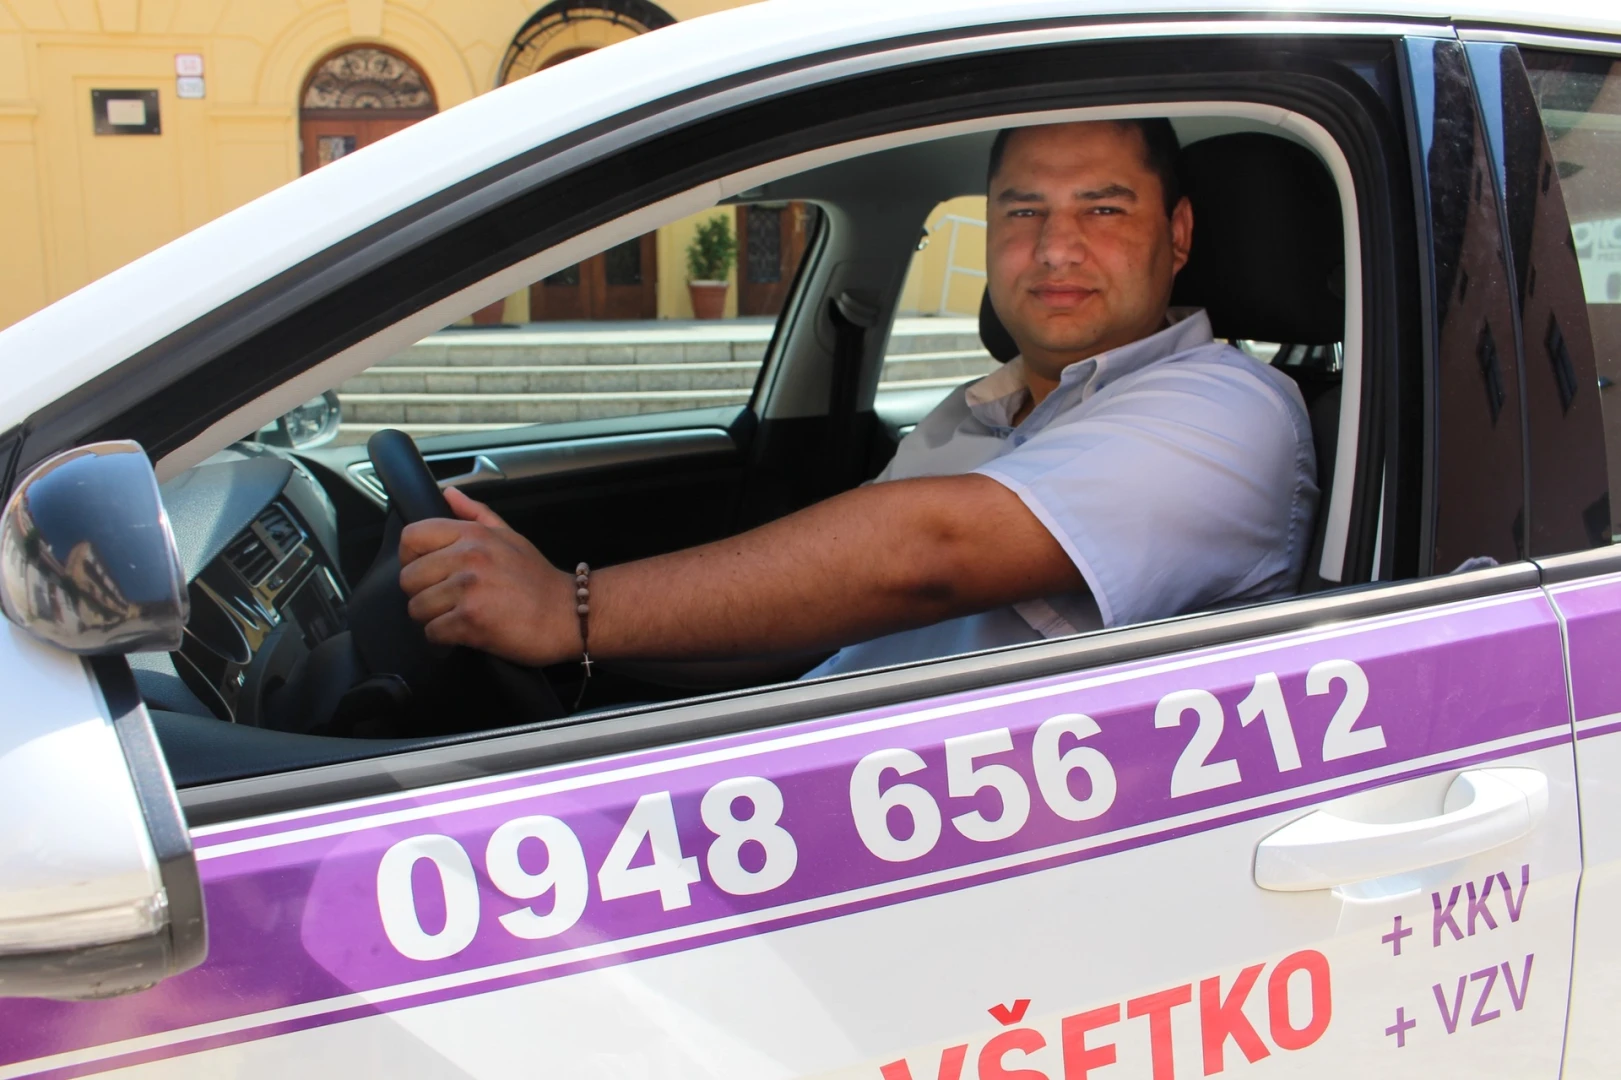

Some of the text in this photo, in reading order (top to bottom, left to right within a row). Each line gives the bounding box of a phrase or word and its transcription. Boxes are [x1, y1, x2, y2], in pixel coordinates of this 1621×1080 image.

[377, 658, 1387, 961] 0948 656 212
[1431, 864, 1530, 948] KKV
[880, 949, 1333, 1080] ŠETKO
[1432, 953, 1535, 1035] VZV
